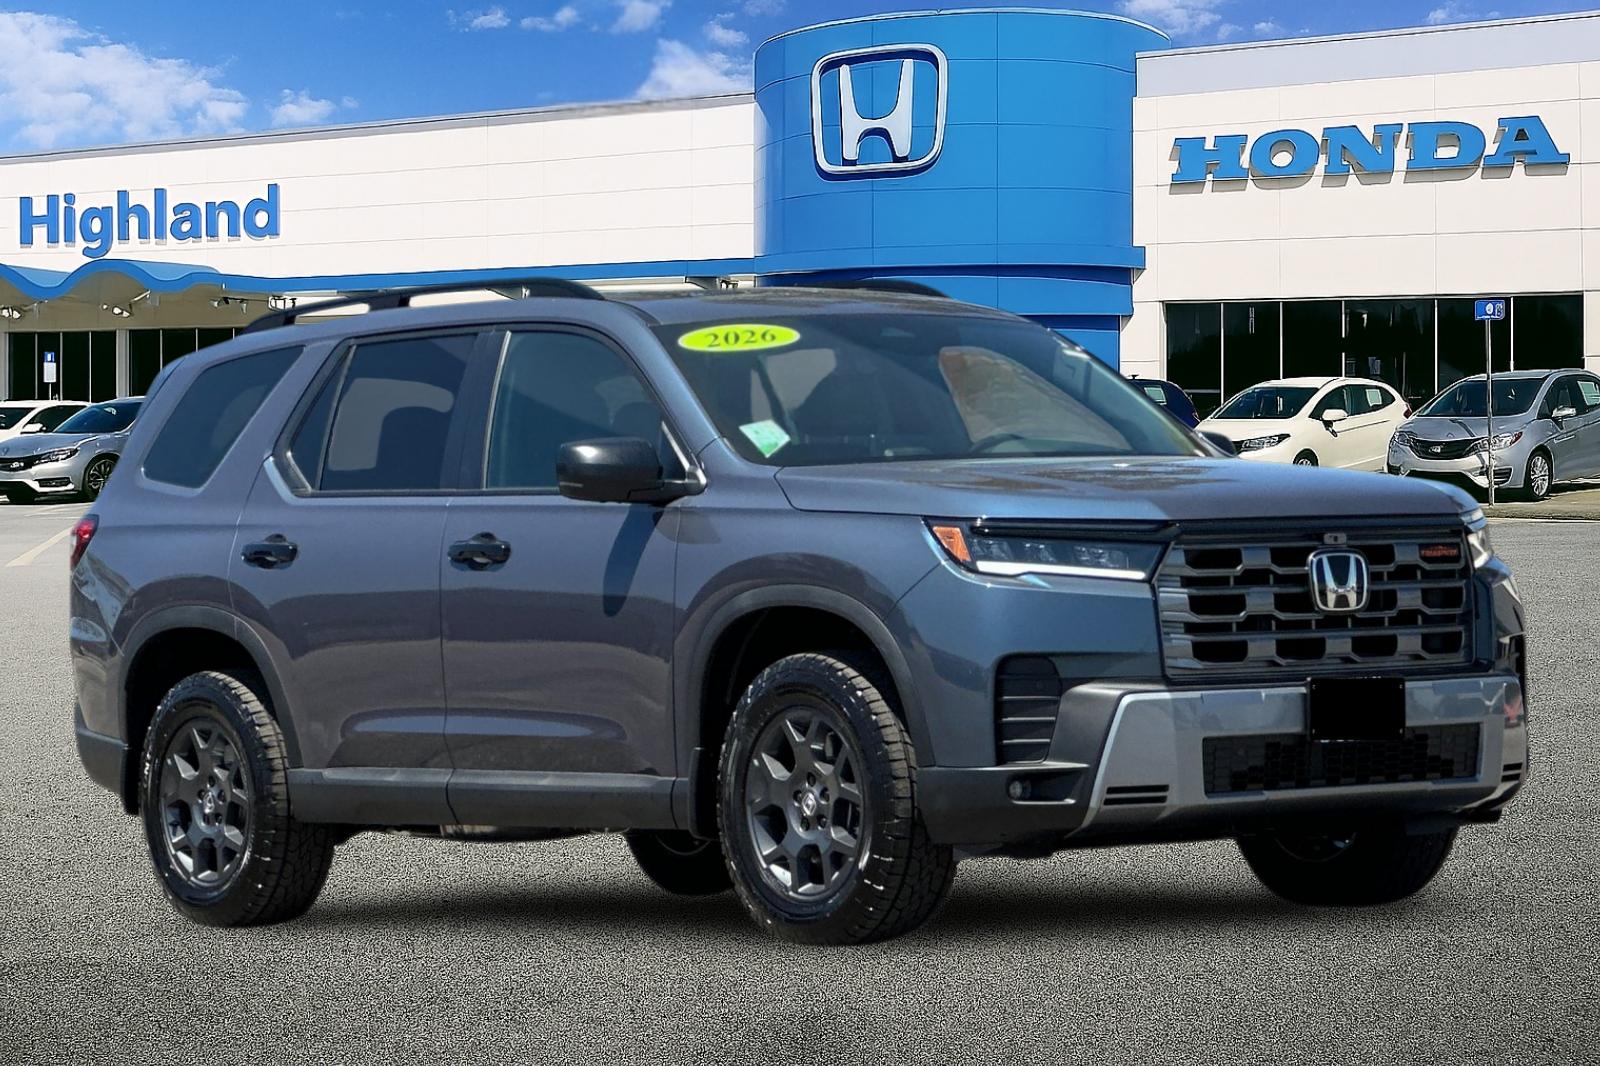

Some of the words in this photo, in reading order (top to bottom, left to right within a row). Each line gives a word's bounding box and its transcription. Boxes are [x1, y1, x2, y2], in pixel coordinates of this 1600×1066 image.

[1171, 115, 1571, 185] HONDA
[19, 183, 280, 258] Highland
[705, 329, 776, 347] 2026
